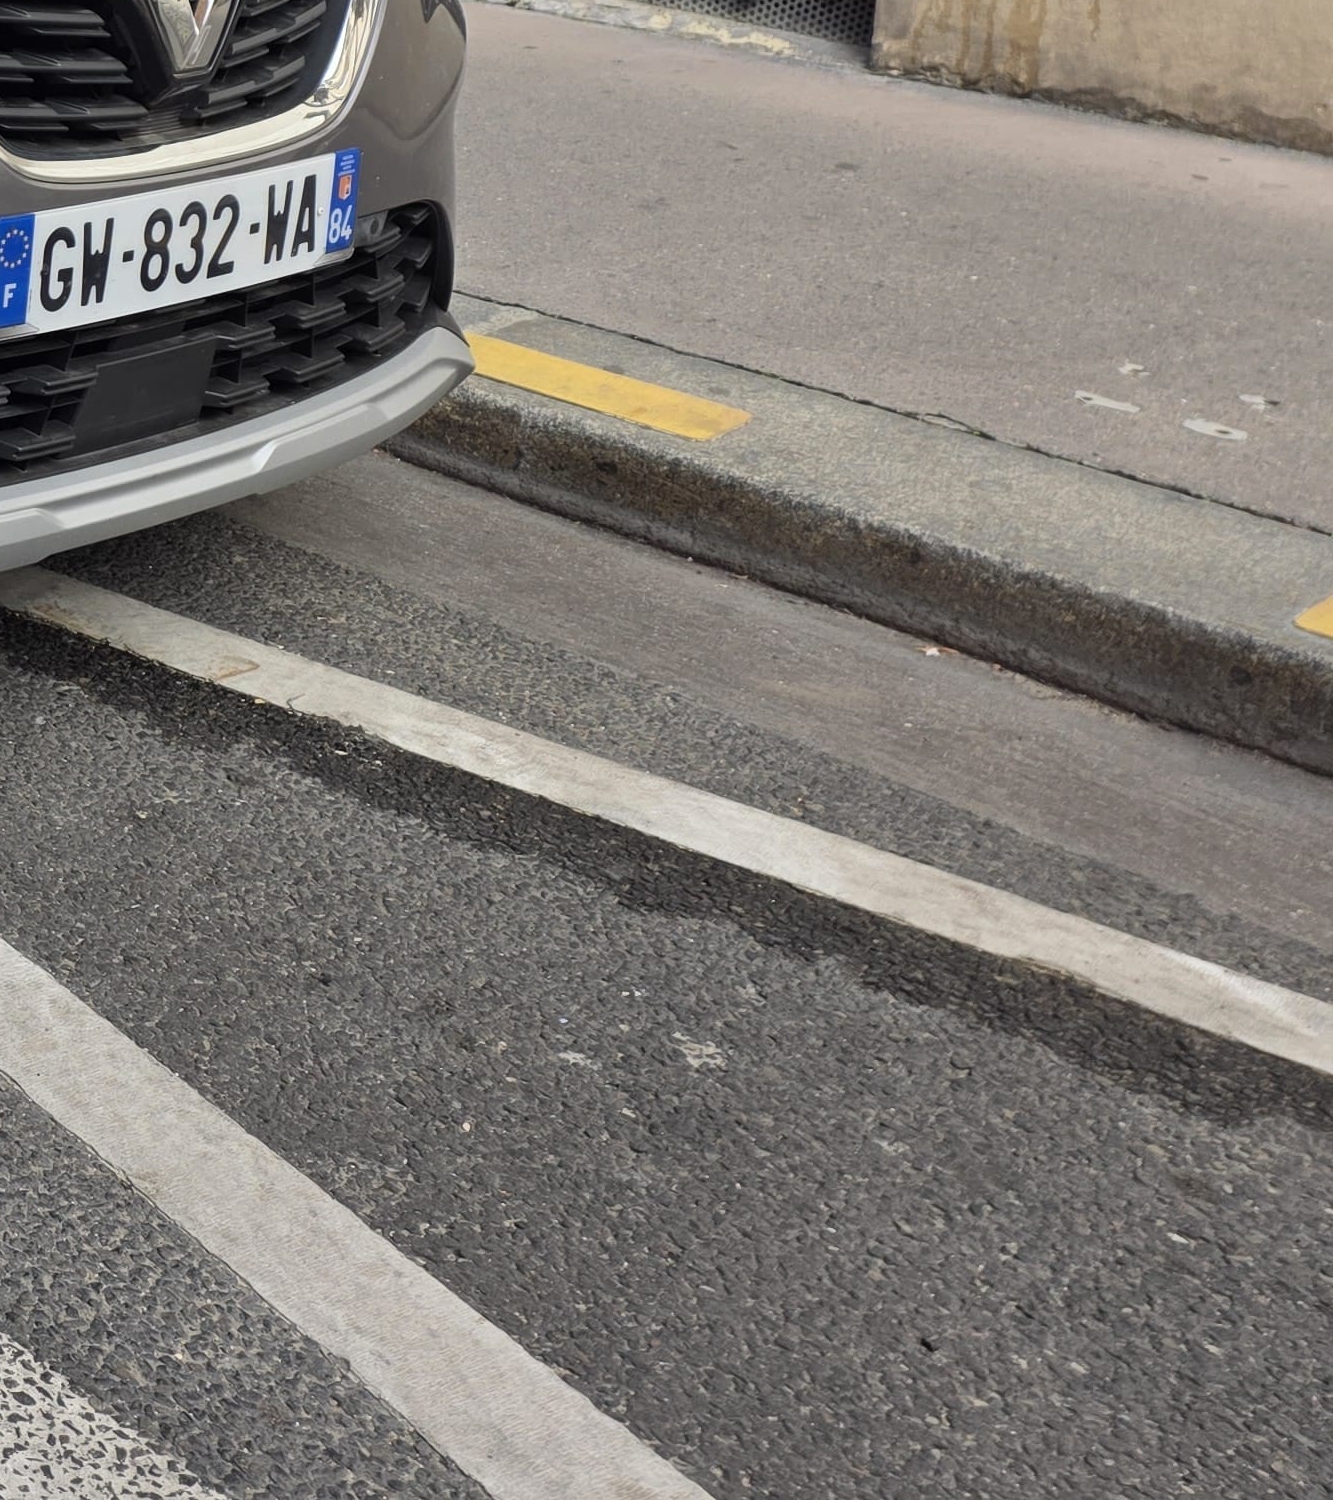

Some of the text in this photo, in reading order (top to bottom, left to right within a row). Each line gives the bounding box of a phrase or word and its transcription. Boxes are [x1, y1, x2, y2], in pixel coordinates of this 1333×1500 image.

[40, 173, 318, 312] GW-832-WA
[328, 203, 354, 244] 84
[2, 282, 18, 309] F
